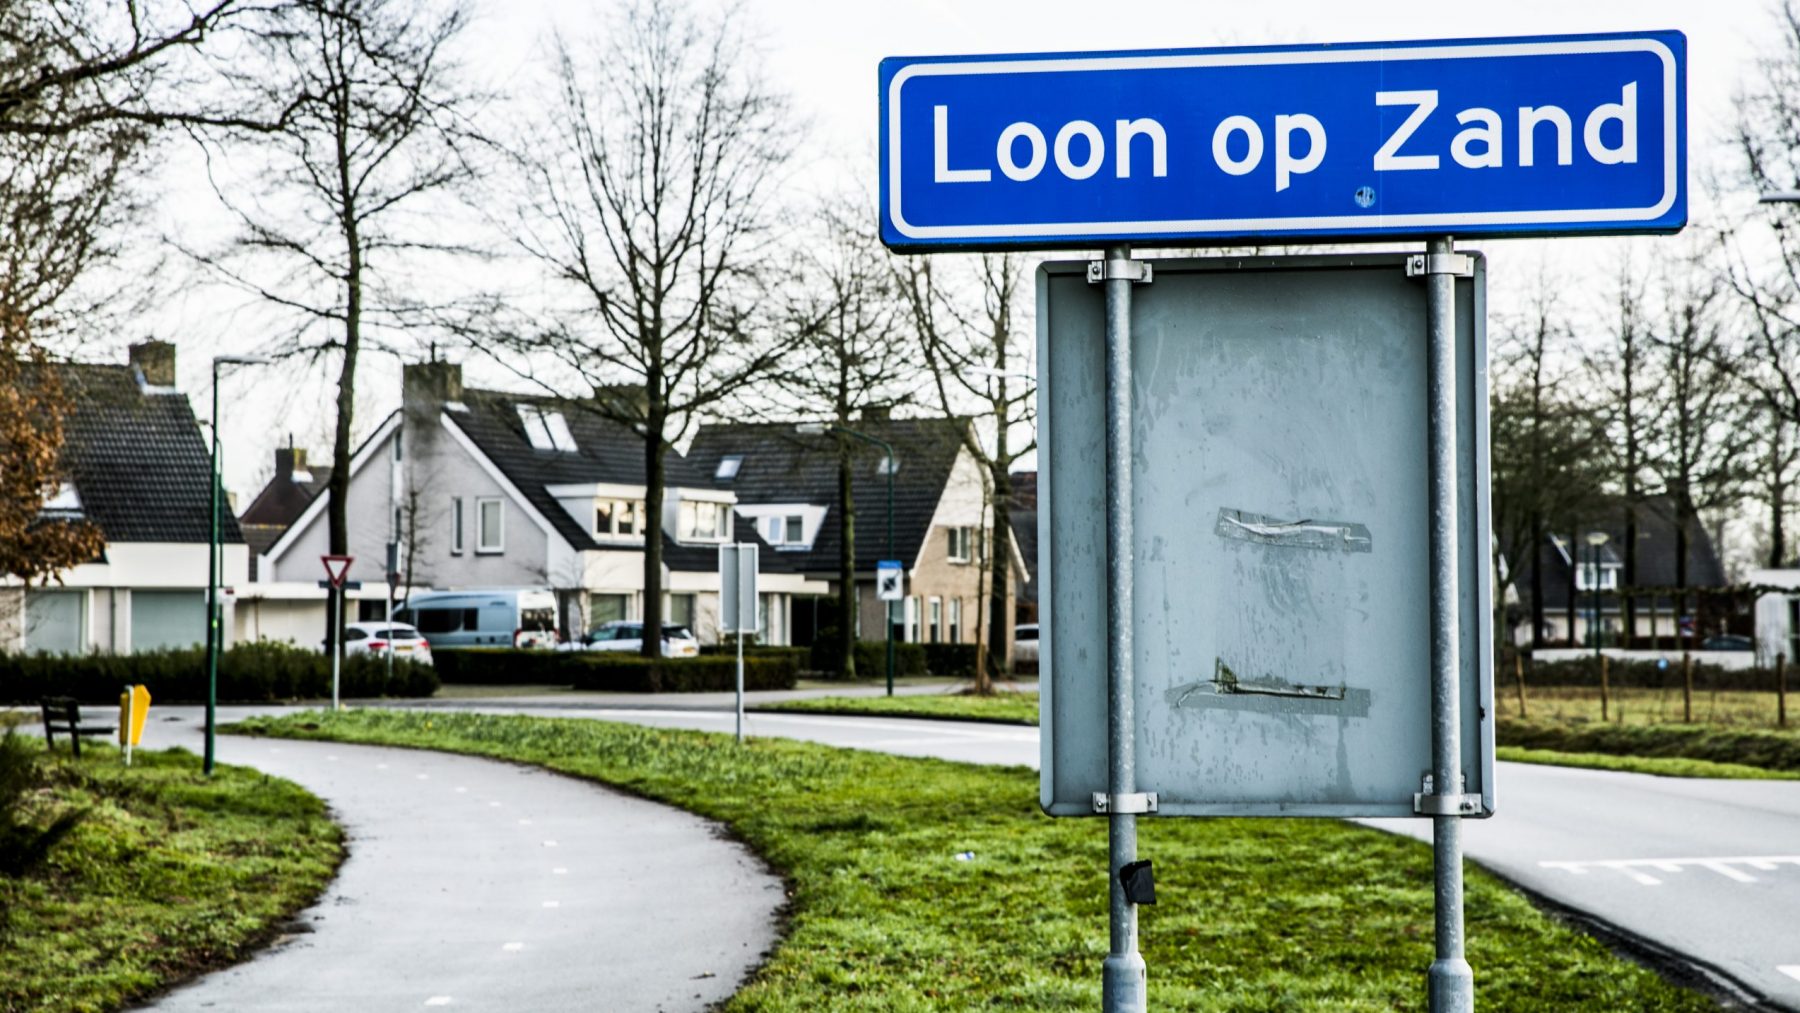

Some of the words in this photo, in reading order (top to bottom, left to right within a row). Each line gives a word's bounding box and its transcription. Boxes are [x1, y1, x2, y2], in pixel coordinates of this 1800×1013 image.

[934, 105, 1168, 183] Loon
[1212, 113, 1328, 192] op
[1373, 80, 1640, 171] Zand
